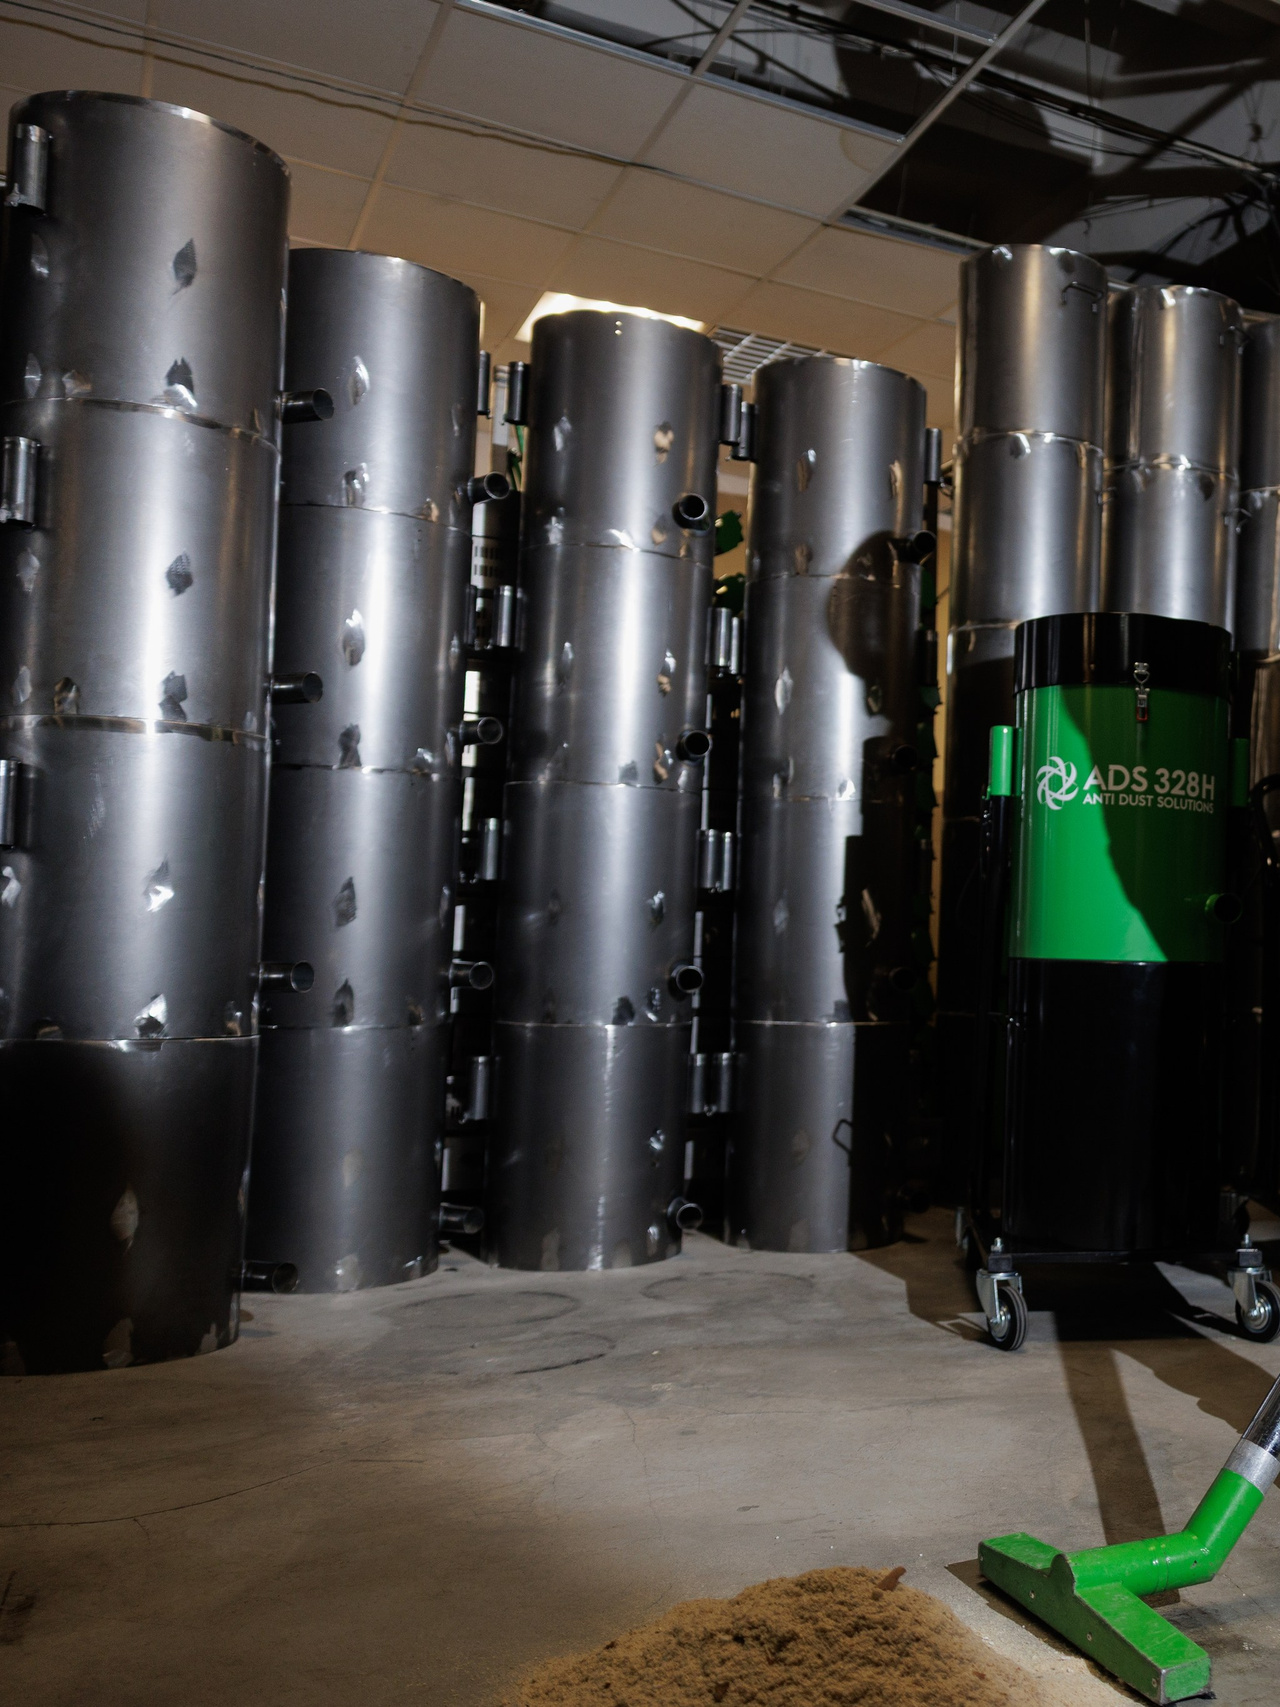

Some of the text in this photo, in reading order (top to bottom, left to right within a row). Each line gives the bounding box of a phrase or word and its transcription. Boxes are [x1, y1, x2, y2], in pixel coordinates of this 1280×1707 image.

[1083, 764, 1215, 800] ADS 328H
[1083, 793, 1215, 814] ANTI DUST SOLUTIONS
